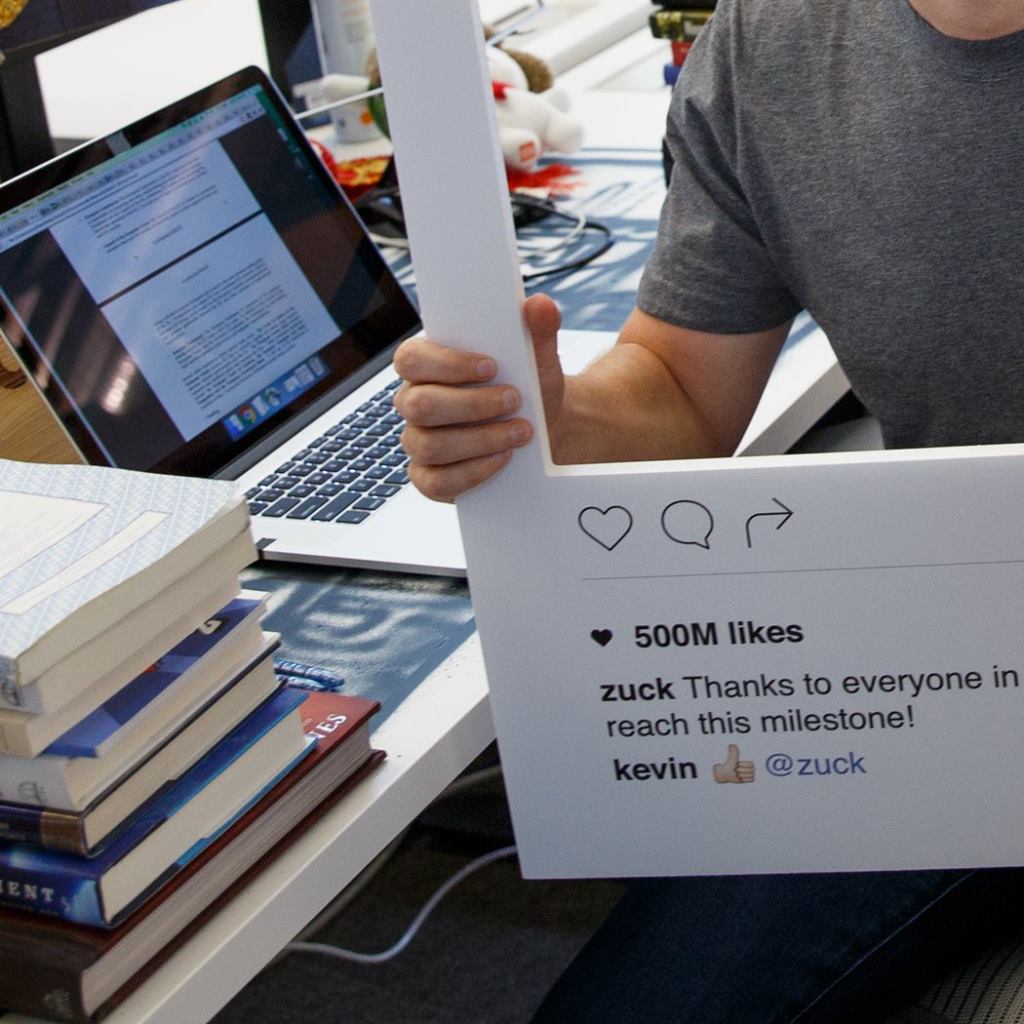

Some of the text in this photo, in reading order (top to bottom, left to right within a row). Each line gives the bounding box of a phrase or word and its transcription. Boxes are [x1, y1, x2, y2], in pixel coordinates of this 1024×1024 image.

[634, 620, 805, 649] 500M likes
[599, 676, 677, 703] zuck
[681, 673, 796, 700] Thanks
[802, 673, 833, 696] to
[841, 671, 983, 698] everyone
[992, 664, 1020, 689] in
[606, 704, 915, 738] reach this milestone!
[612, 751, 867, 782] kevin @zuck
[0, 879, 55, 903] ENT
